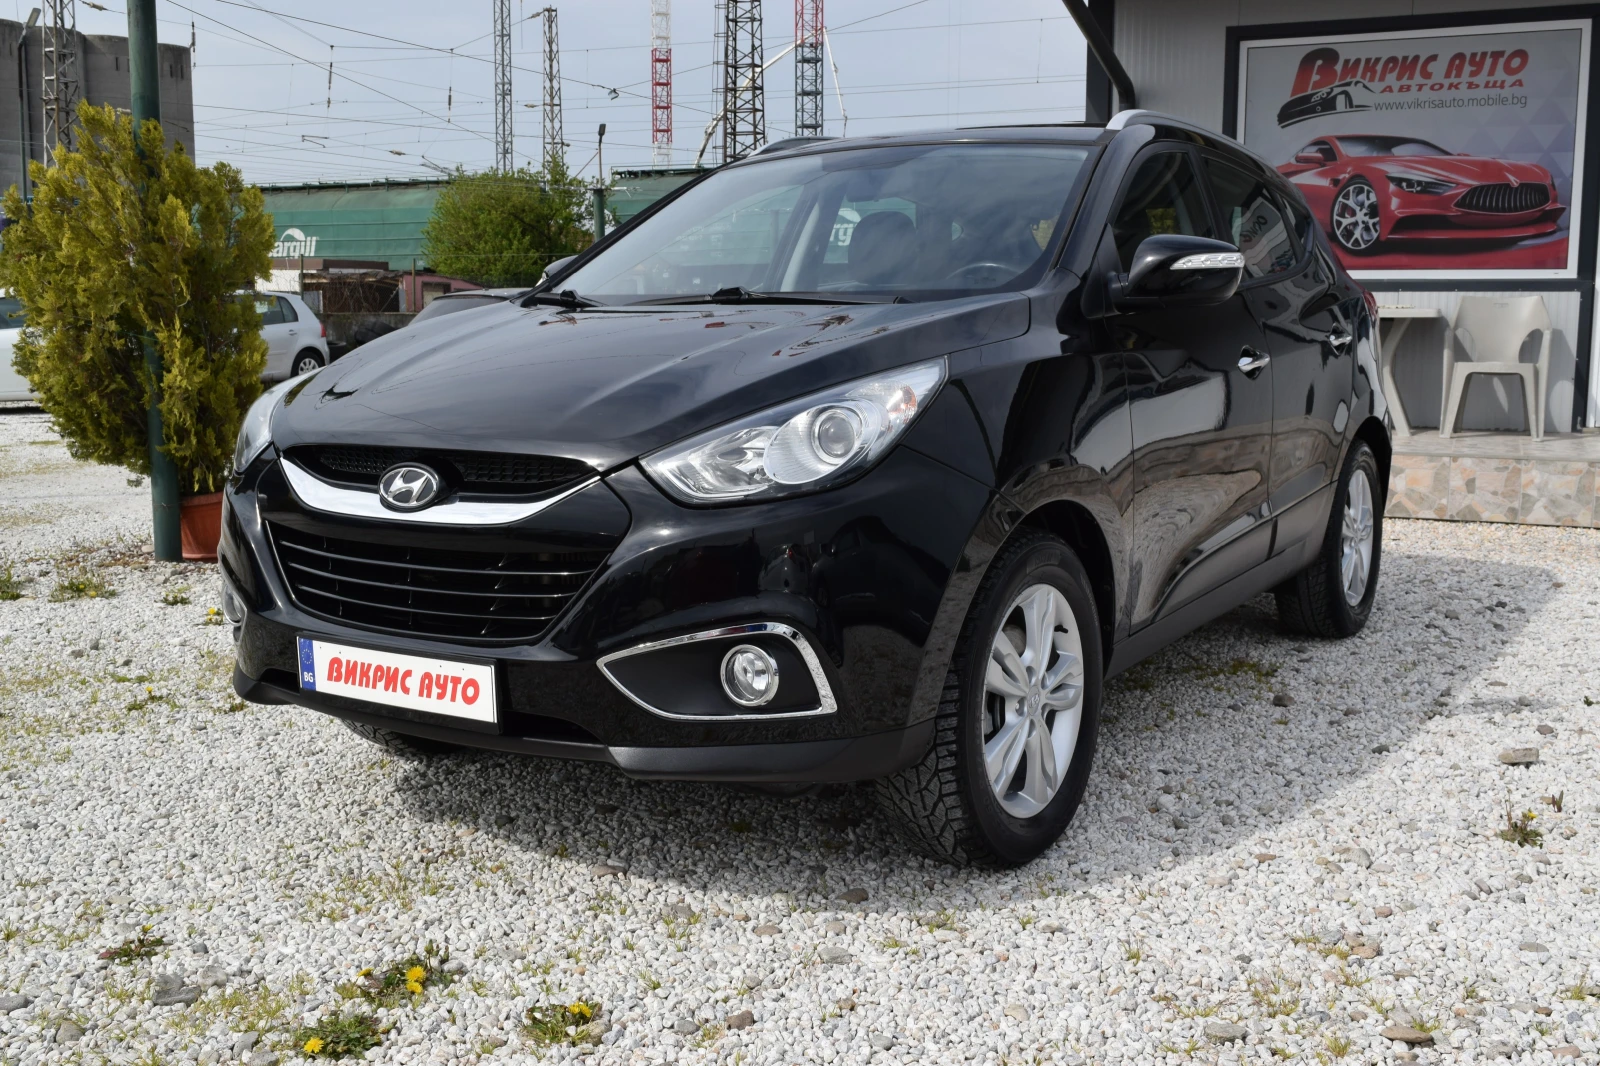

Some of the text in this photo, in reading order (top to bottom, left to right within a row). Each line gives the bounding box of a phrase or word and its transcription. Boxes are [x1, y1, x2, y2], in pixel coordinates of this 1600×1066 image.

[1290, 47, 1529, 98] ВИКРИС АУТО
[1379, 78, 1525, 94] АВТОКЪЩА
[1374, 93, 1528, 111] www.vikrisauto.mobile.bg
[268, 236, 317, 260] argill
[304, 671, 314, 683] BG
[327, 656, 480, 705] ВИКРИС АУТО
